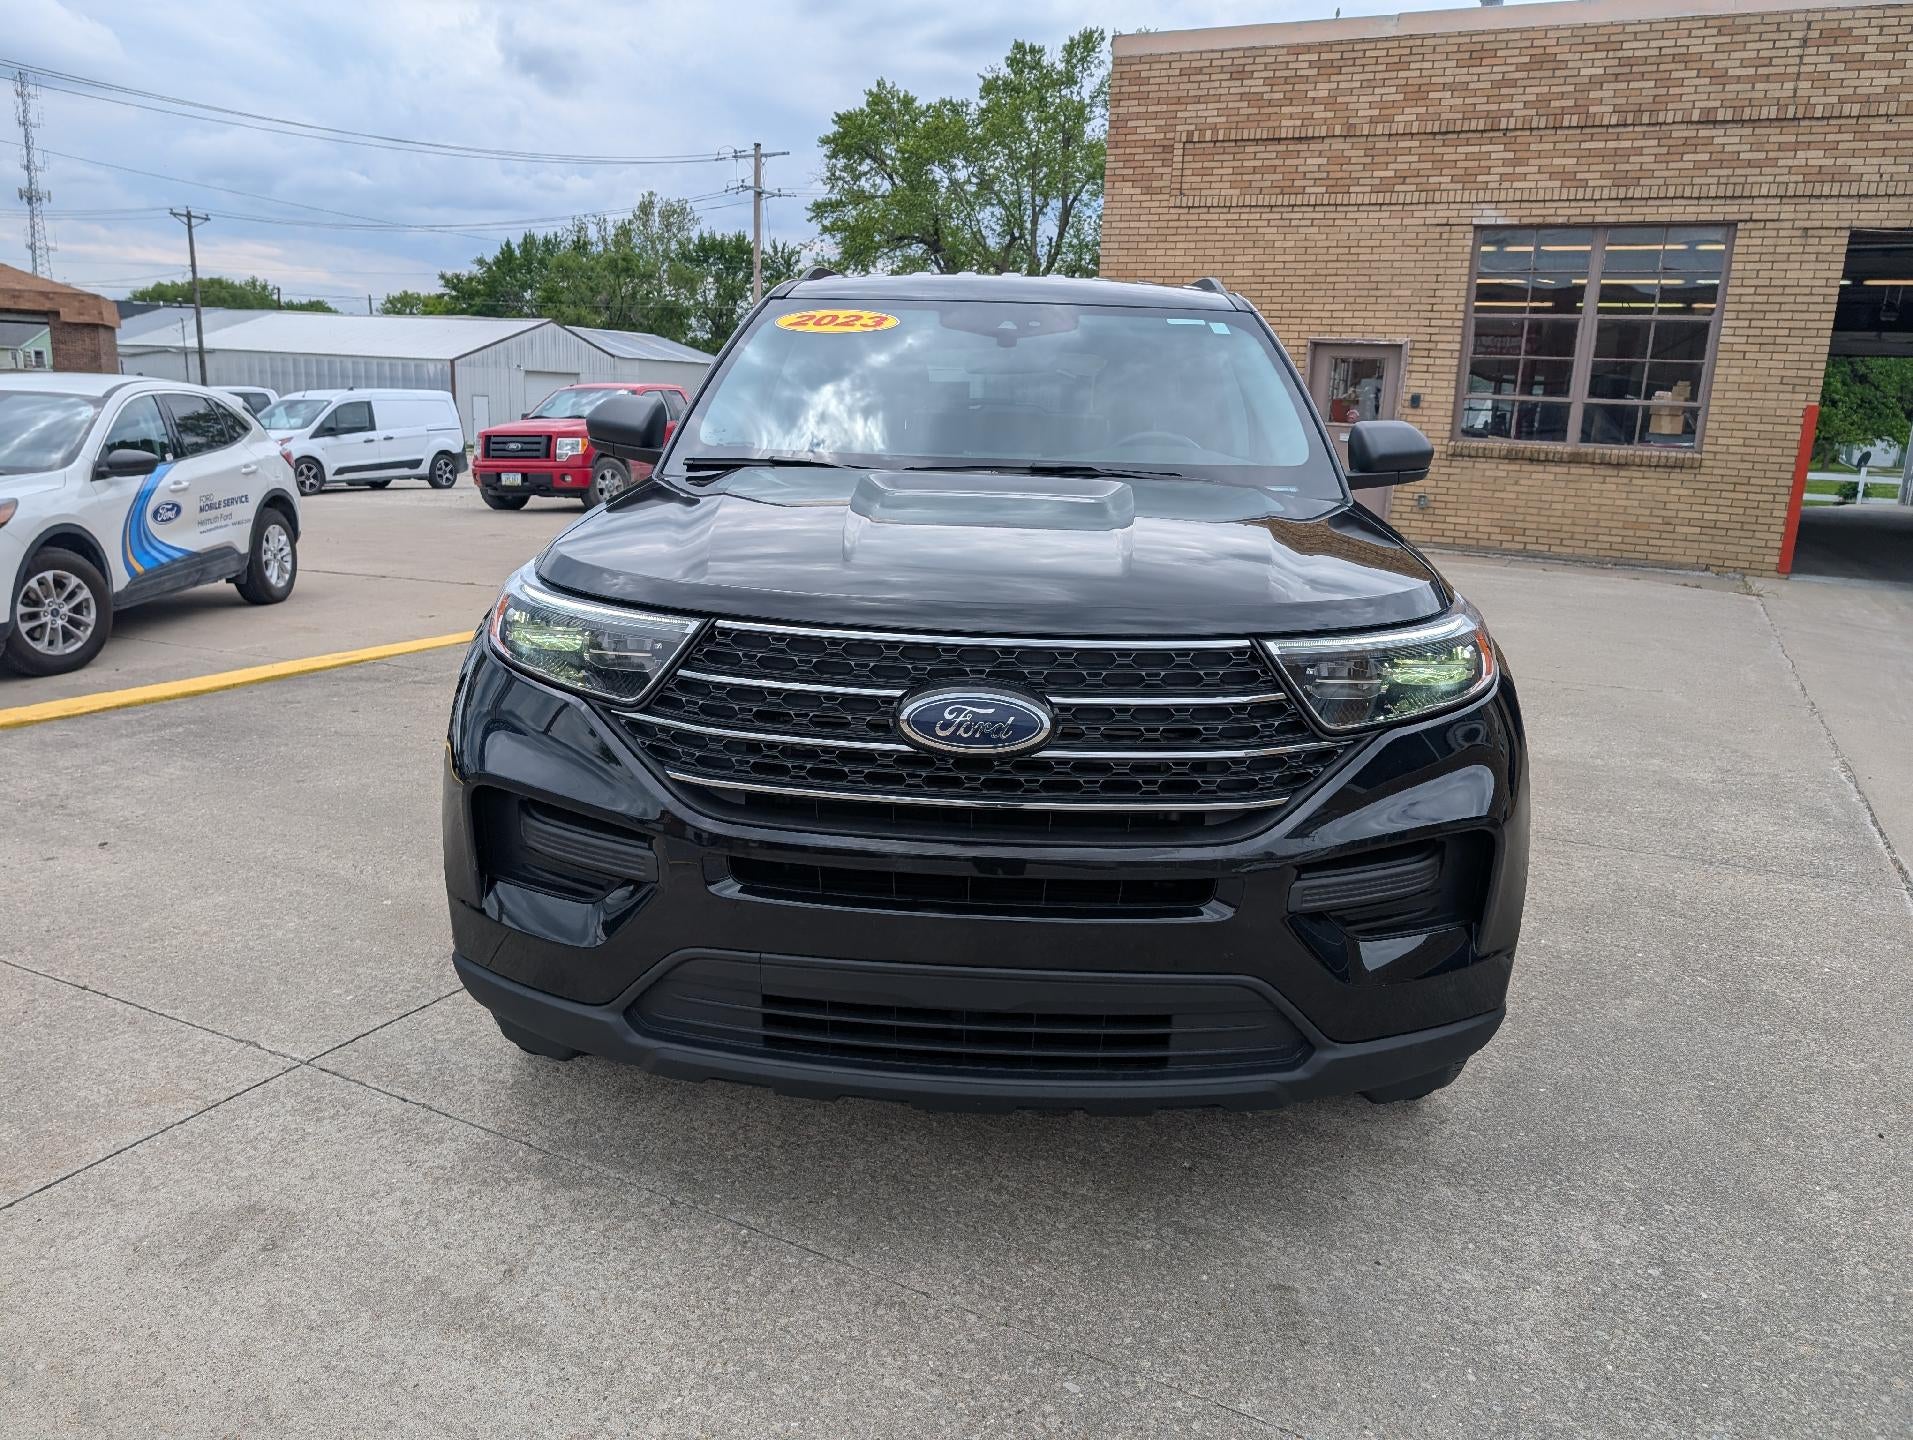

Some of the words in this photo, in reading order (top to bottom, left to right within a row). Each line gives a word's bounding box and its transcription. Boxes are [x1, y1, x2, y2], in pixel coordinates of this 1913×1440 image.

[785, 314, 888, 328] 2023
[199, 493, 214, 504] FORD
[199, 500, 222, 514] MOBILE
[222, 494, 249, 508] SERVICE
[219, 512, 233, 523] Ford
[935, 704, 1016, 740] Ford
